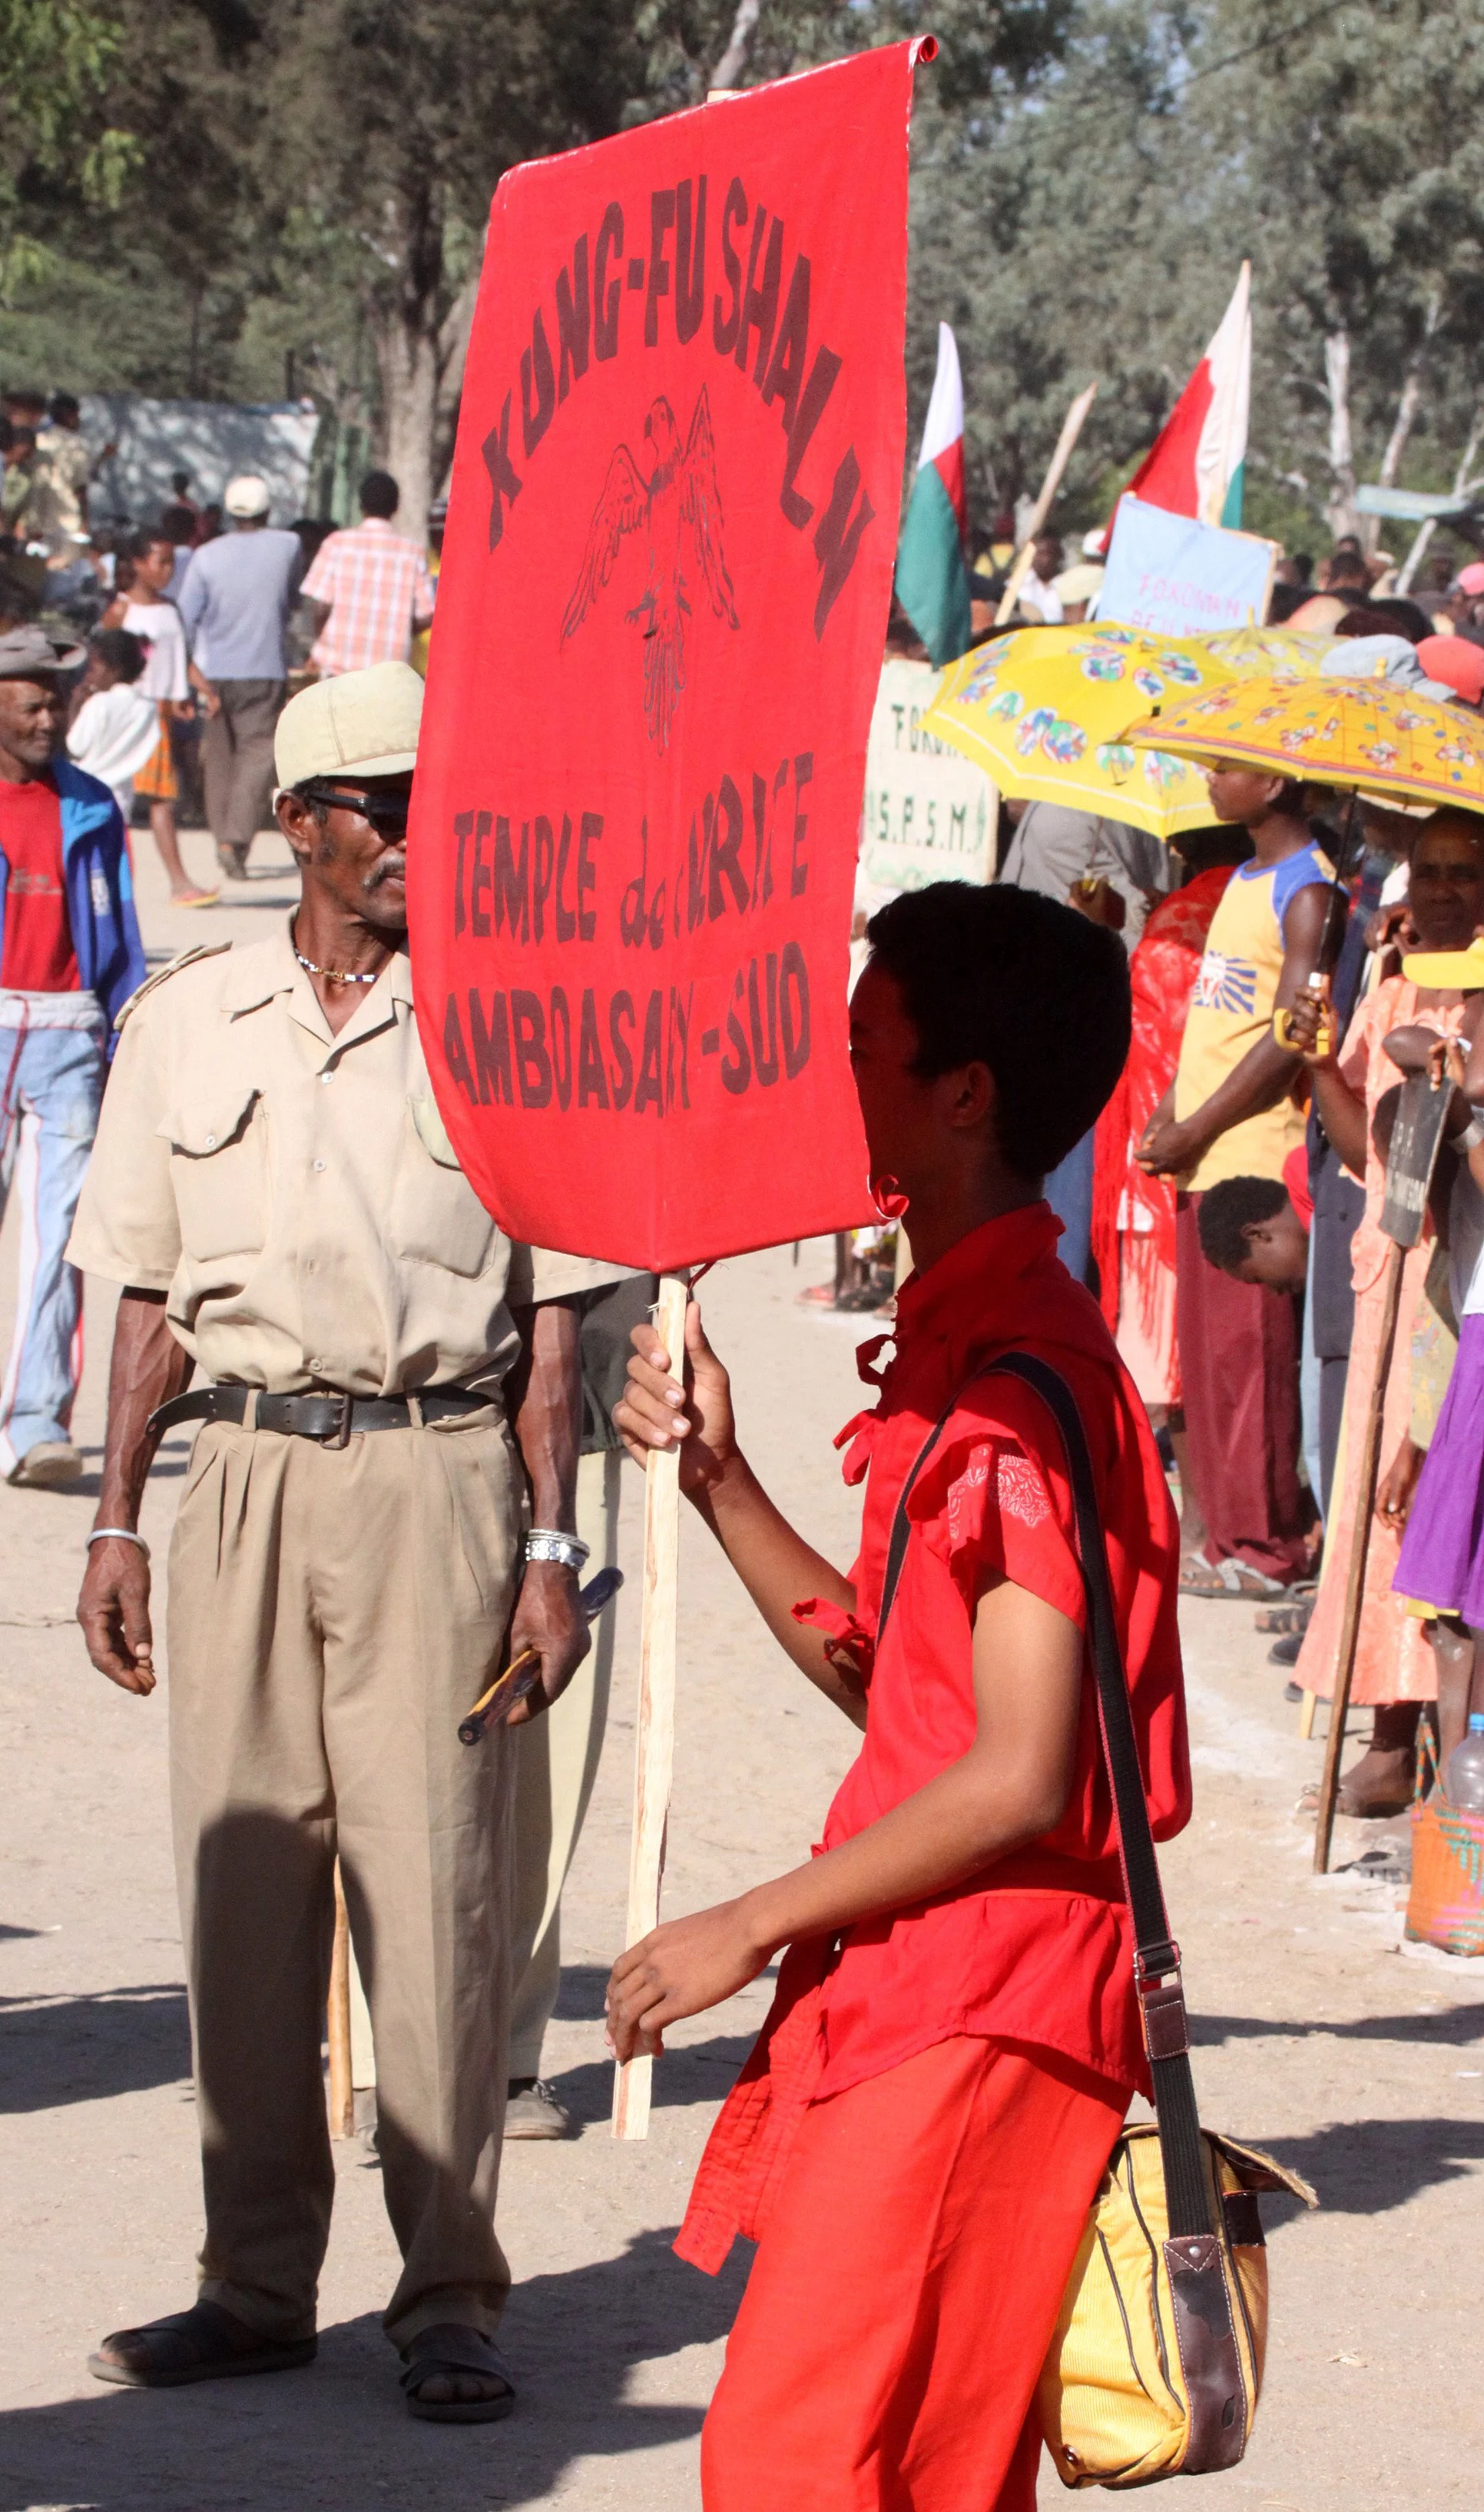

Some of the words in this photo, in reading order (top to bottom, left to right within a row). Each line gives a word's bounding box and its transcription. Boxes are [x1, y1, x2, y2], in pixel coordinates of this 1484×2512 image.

[481, 174, 707, 554] KUNG-FU
[453, 810, 605, 946] TEMPLE
[620, 814, 666, 951] de
